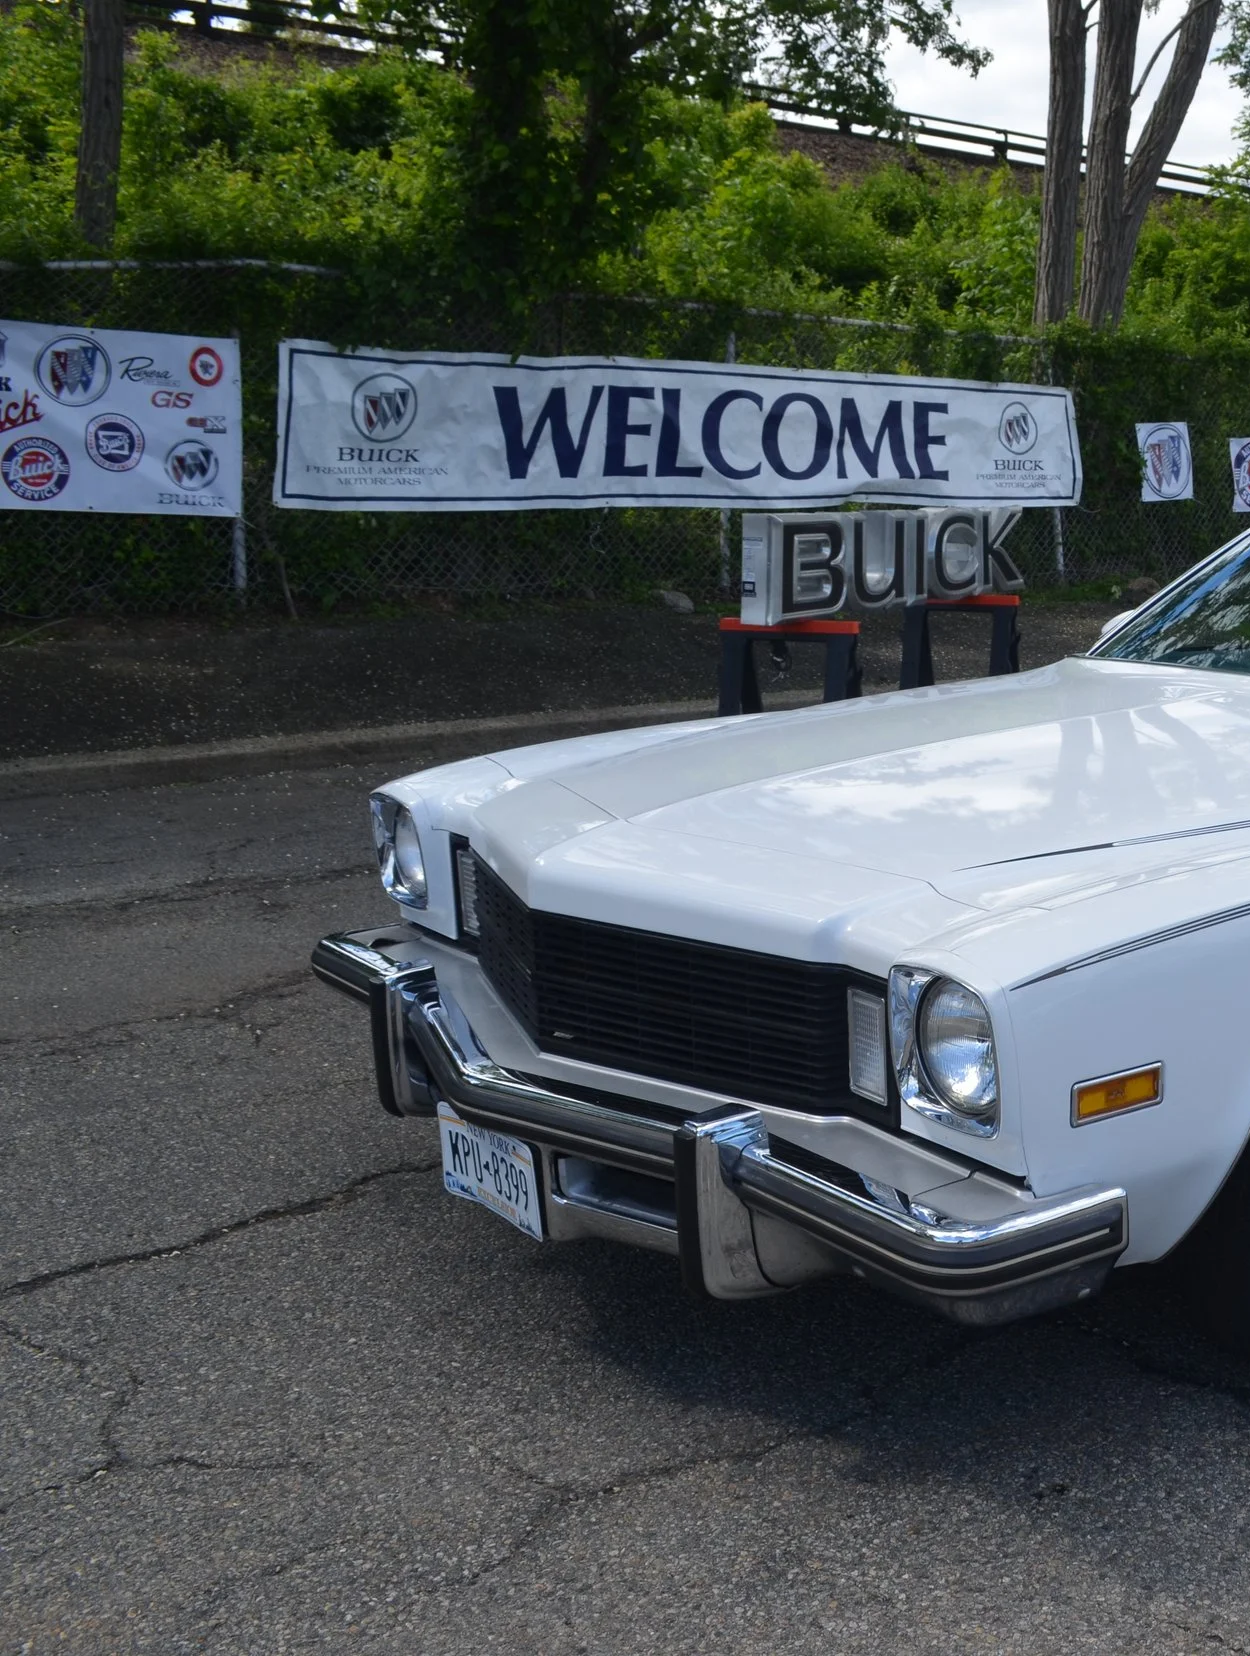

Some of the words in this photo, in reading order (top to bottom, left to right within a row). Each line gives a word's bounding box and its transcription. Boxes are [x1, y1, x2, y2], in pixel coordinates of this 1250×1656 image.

[151, 390, 194, 409] GS
[493, 385, 950, 482] WELCOME
[337, 446, 421, 463] BUICK
[8, 453, 65, 481] Buick
[305, 464, 373, 475] PREMIUM
[377, 465, 449, 476] AMERICAN
[993, 459, 1044, 471] BUICK
[10, 481, 60, 499] SERVICE
[337, 477, 422, 486] MOTORCARS
[157, 493, 224, 507] BUICK
[772, 508, 1024, 625] BUICK
[466, 1121, 487, 1142] NEW
[487, 1129, 514, 1158] YORK
